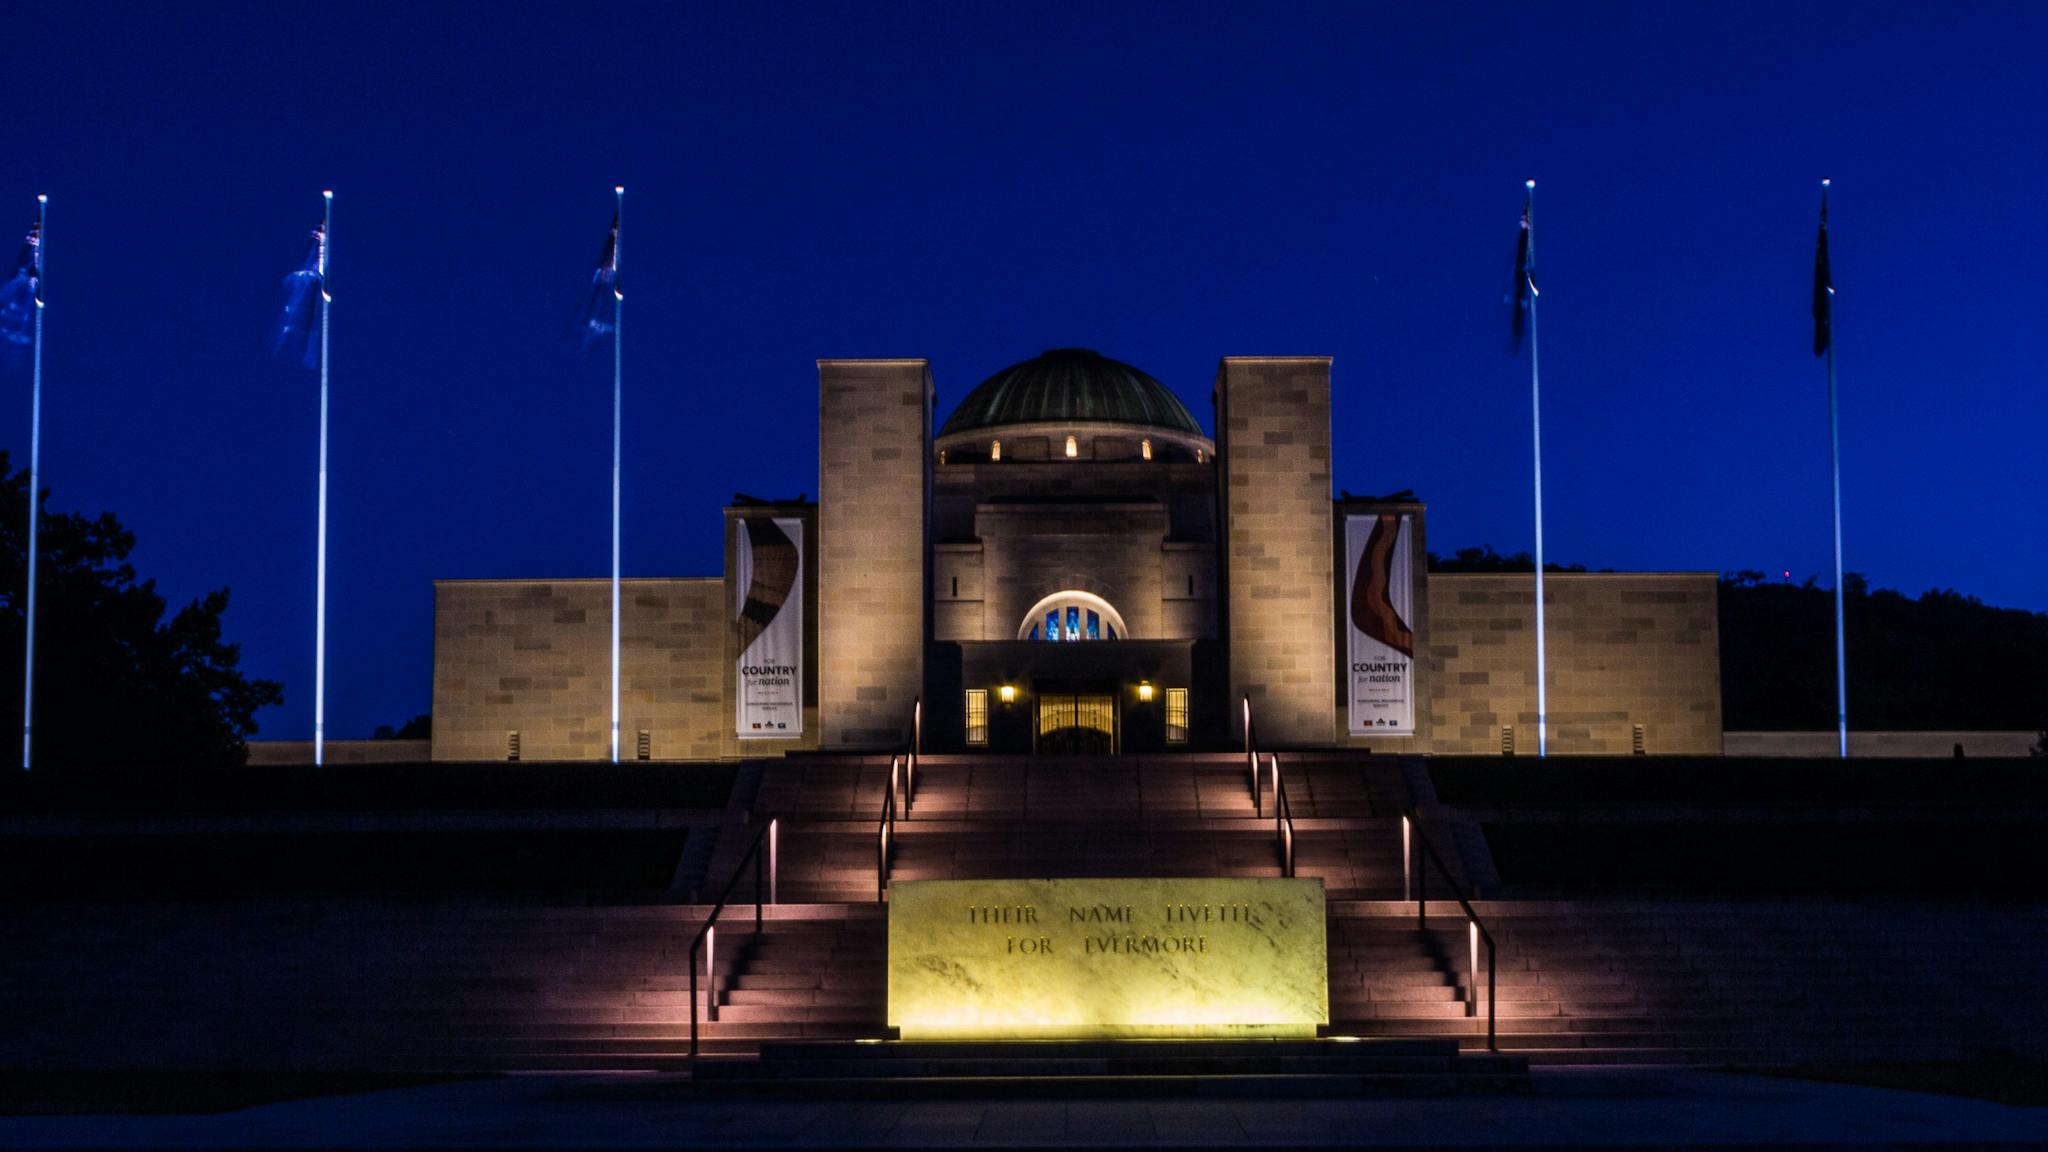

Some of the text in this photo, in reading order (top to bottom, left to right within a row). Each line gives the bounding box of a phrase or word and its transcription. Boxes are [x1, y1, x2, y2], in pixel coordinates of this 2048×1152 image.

[742, 666, 797, 676] COUNTRY
[1352, 663, 1408, 672] COUNTRY
[758, 676, 790, 686] nation
[1369, 673, 1400, 682] nation
[969, 904, 1250, 924] THEIR NAME LIVETH
[1007, 936, 1209, 955] FOR EVERMORE
